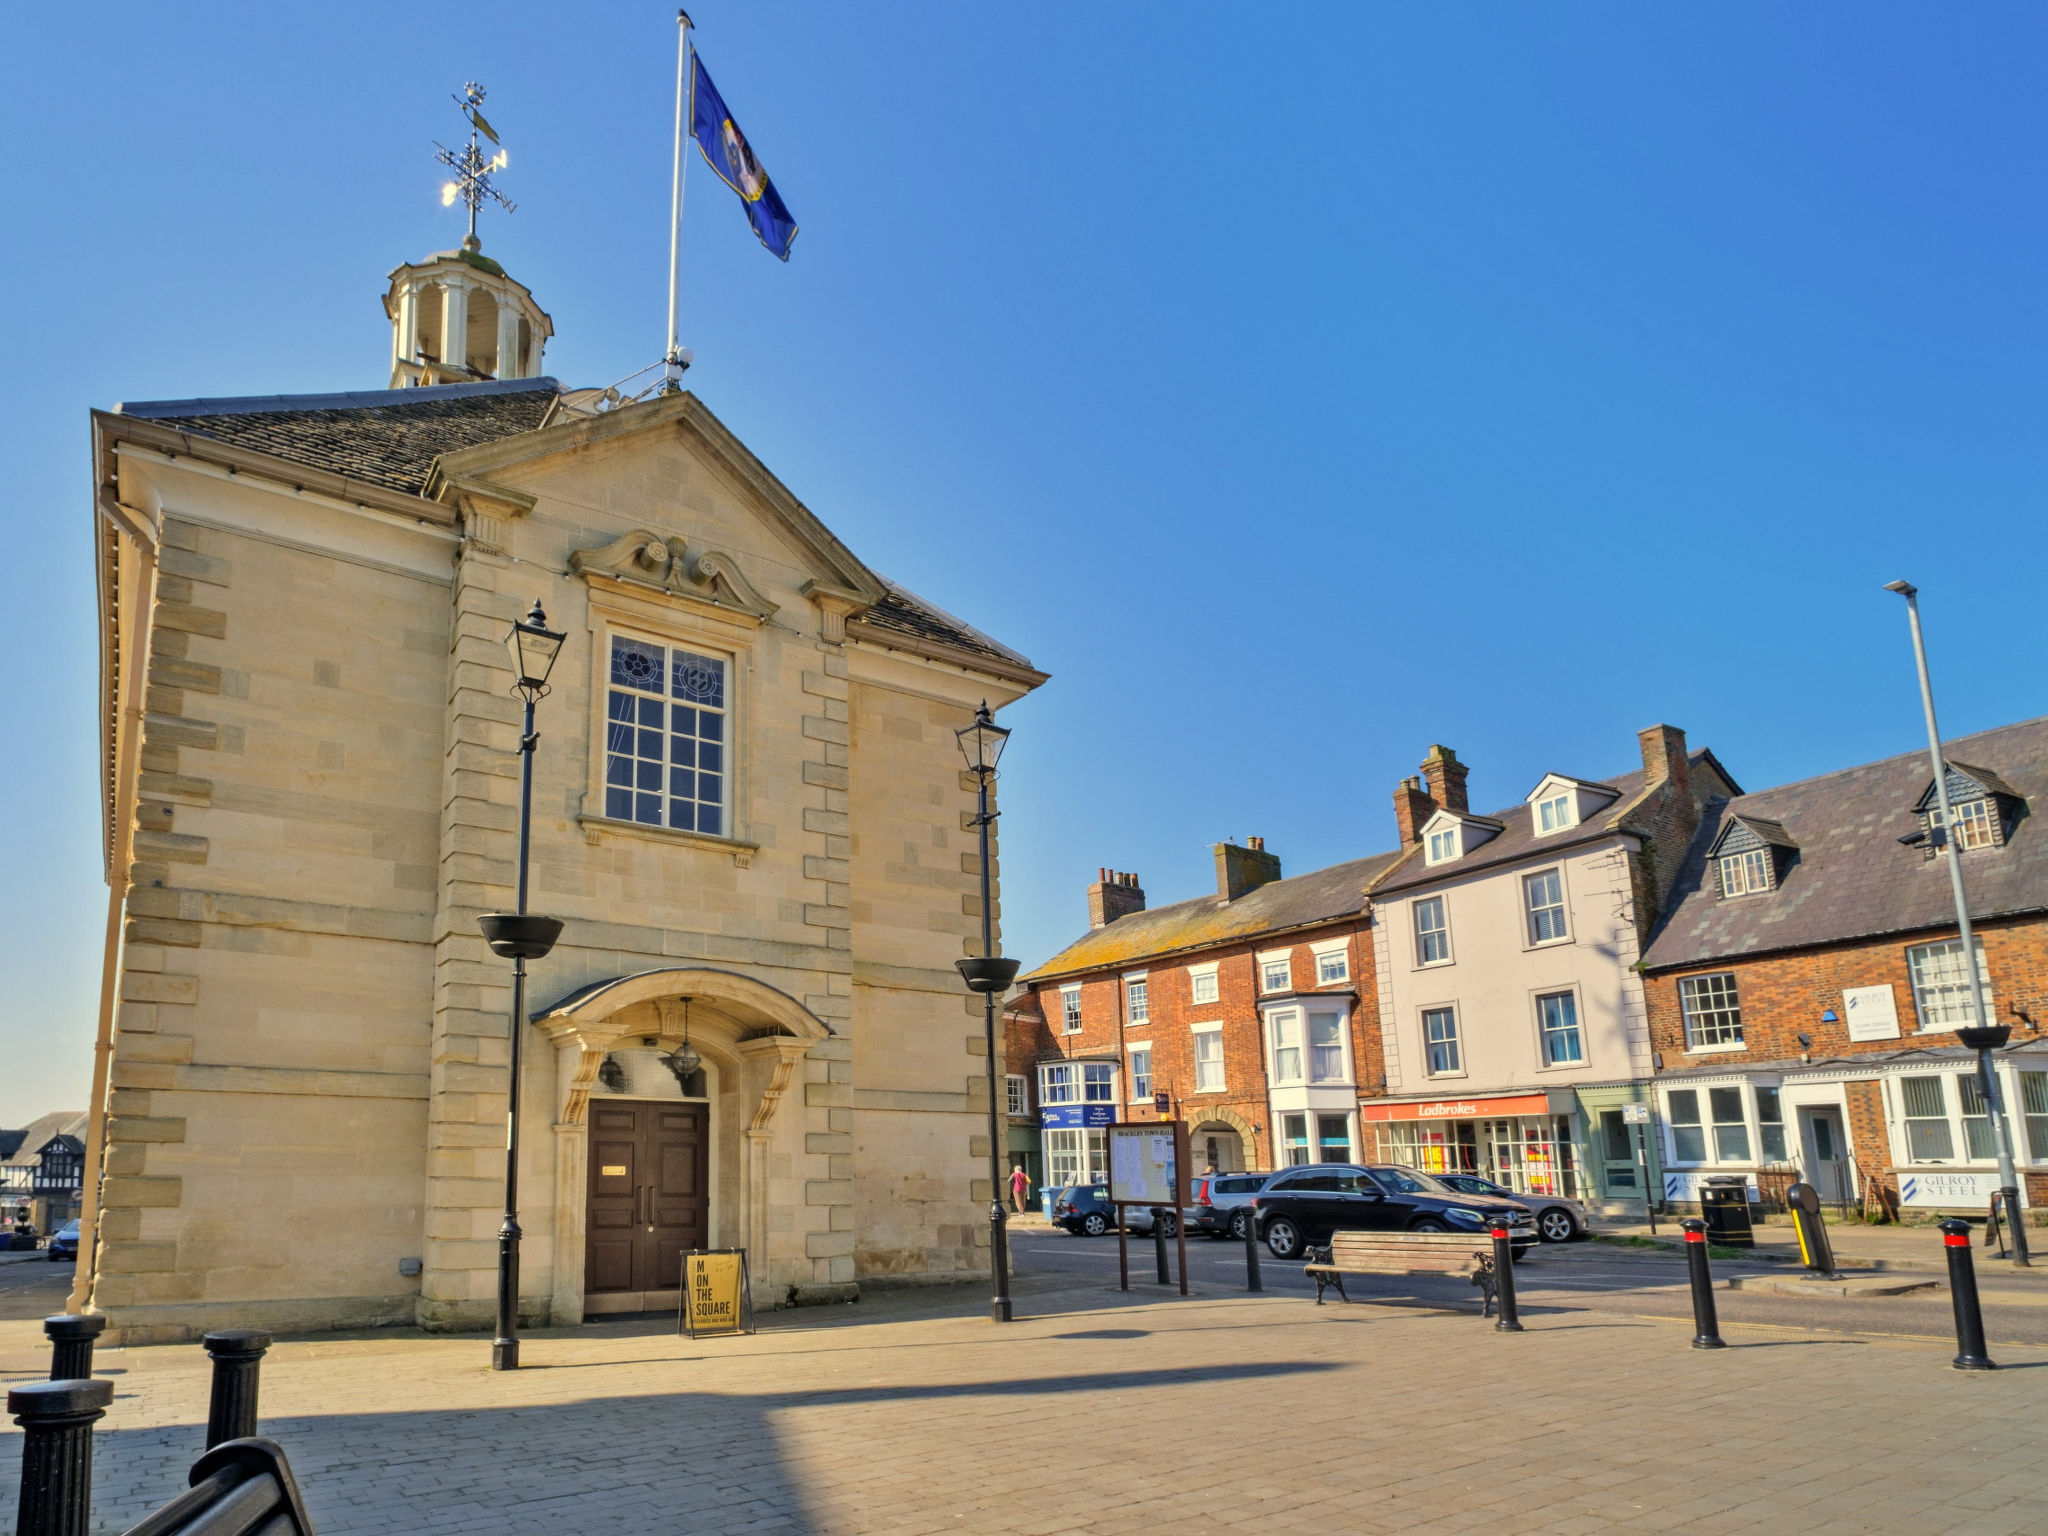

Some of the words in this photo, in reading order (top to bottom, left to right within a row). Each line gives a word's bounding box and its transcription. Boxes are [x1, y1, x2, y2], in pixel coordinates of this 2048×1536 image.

[1418, 1101, 1477, 1117] Ladbrokes
[1925, 1175, 1978, 1185] GILROY
[1927, 1186, 1981, 1196] STEEL
[697, 1260, 705, 1273] M
[696, 1274, 709, 1287] ON
[696, 1288, 712, 1301] THE
[696, 1301, 731, 1316] SQUARE
